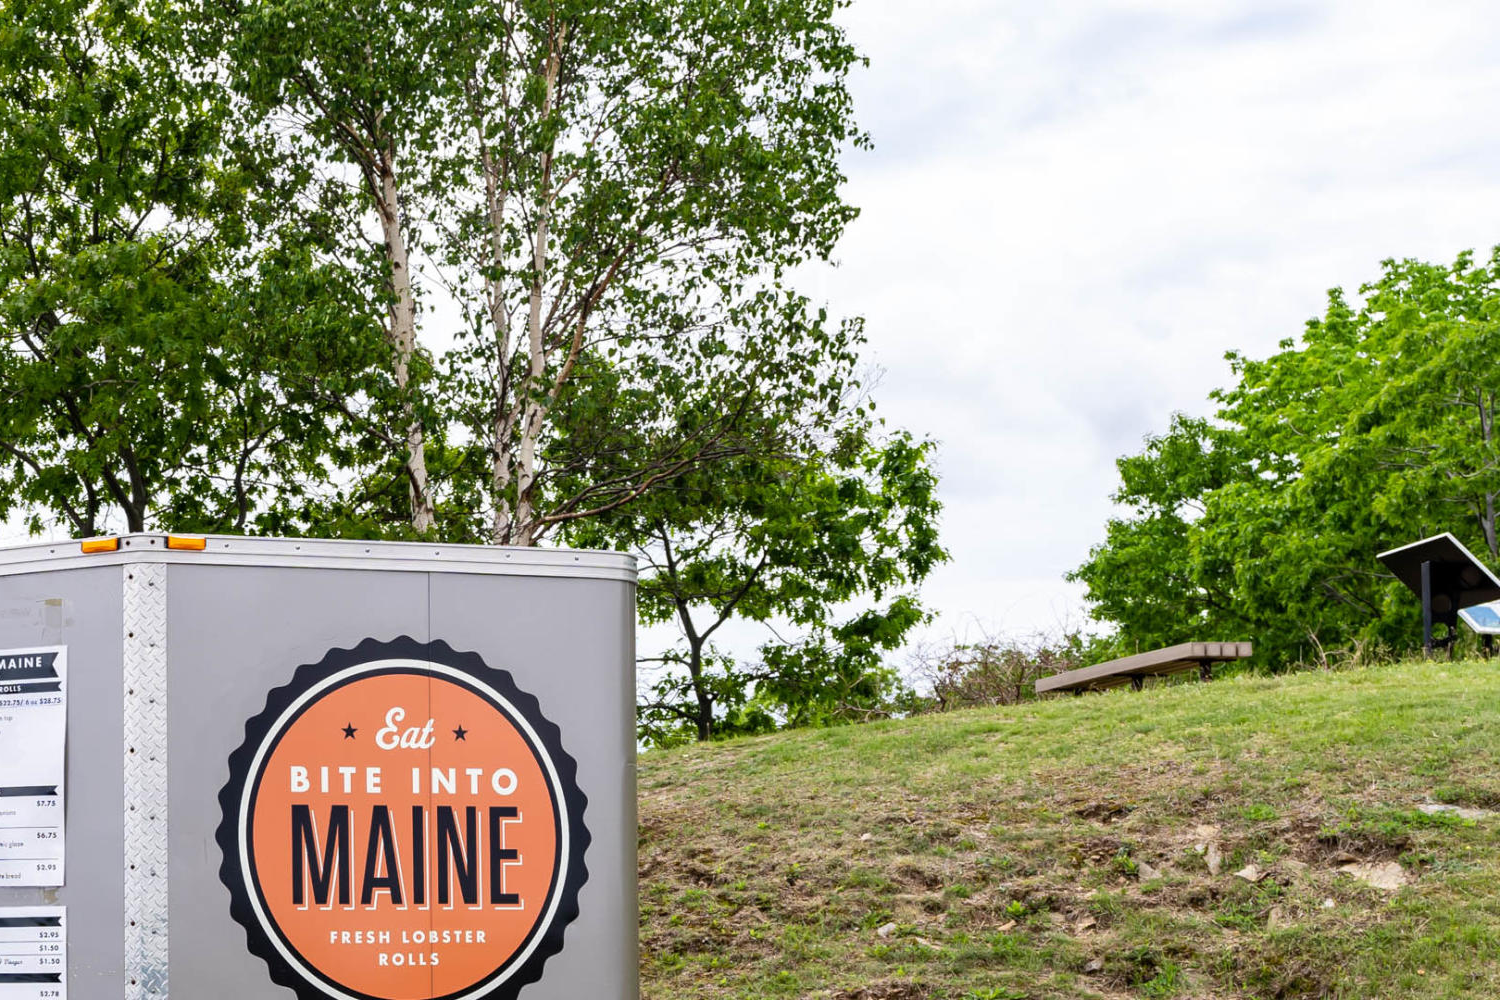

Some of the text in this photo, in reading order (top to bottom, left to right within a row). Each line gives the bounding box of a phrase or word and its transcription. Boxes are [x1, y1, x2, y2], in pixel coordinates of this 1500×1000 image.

[375, 707, 436, 750] Eat
[290, 766, 518, 795] BITE INTO
[291, 804, 524, 910] MAINE
[330, 931, 486, 944] FRESH LOBSTER
[379, 954, 439, 966] ROLLS
